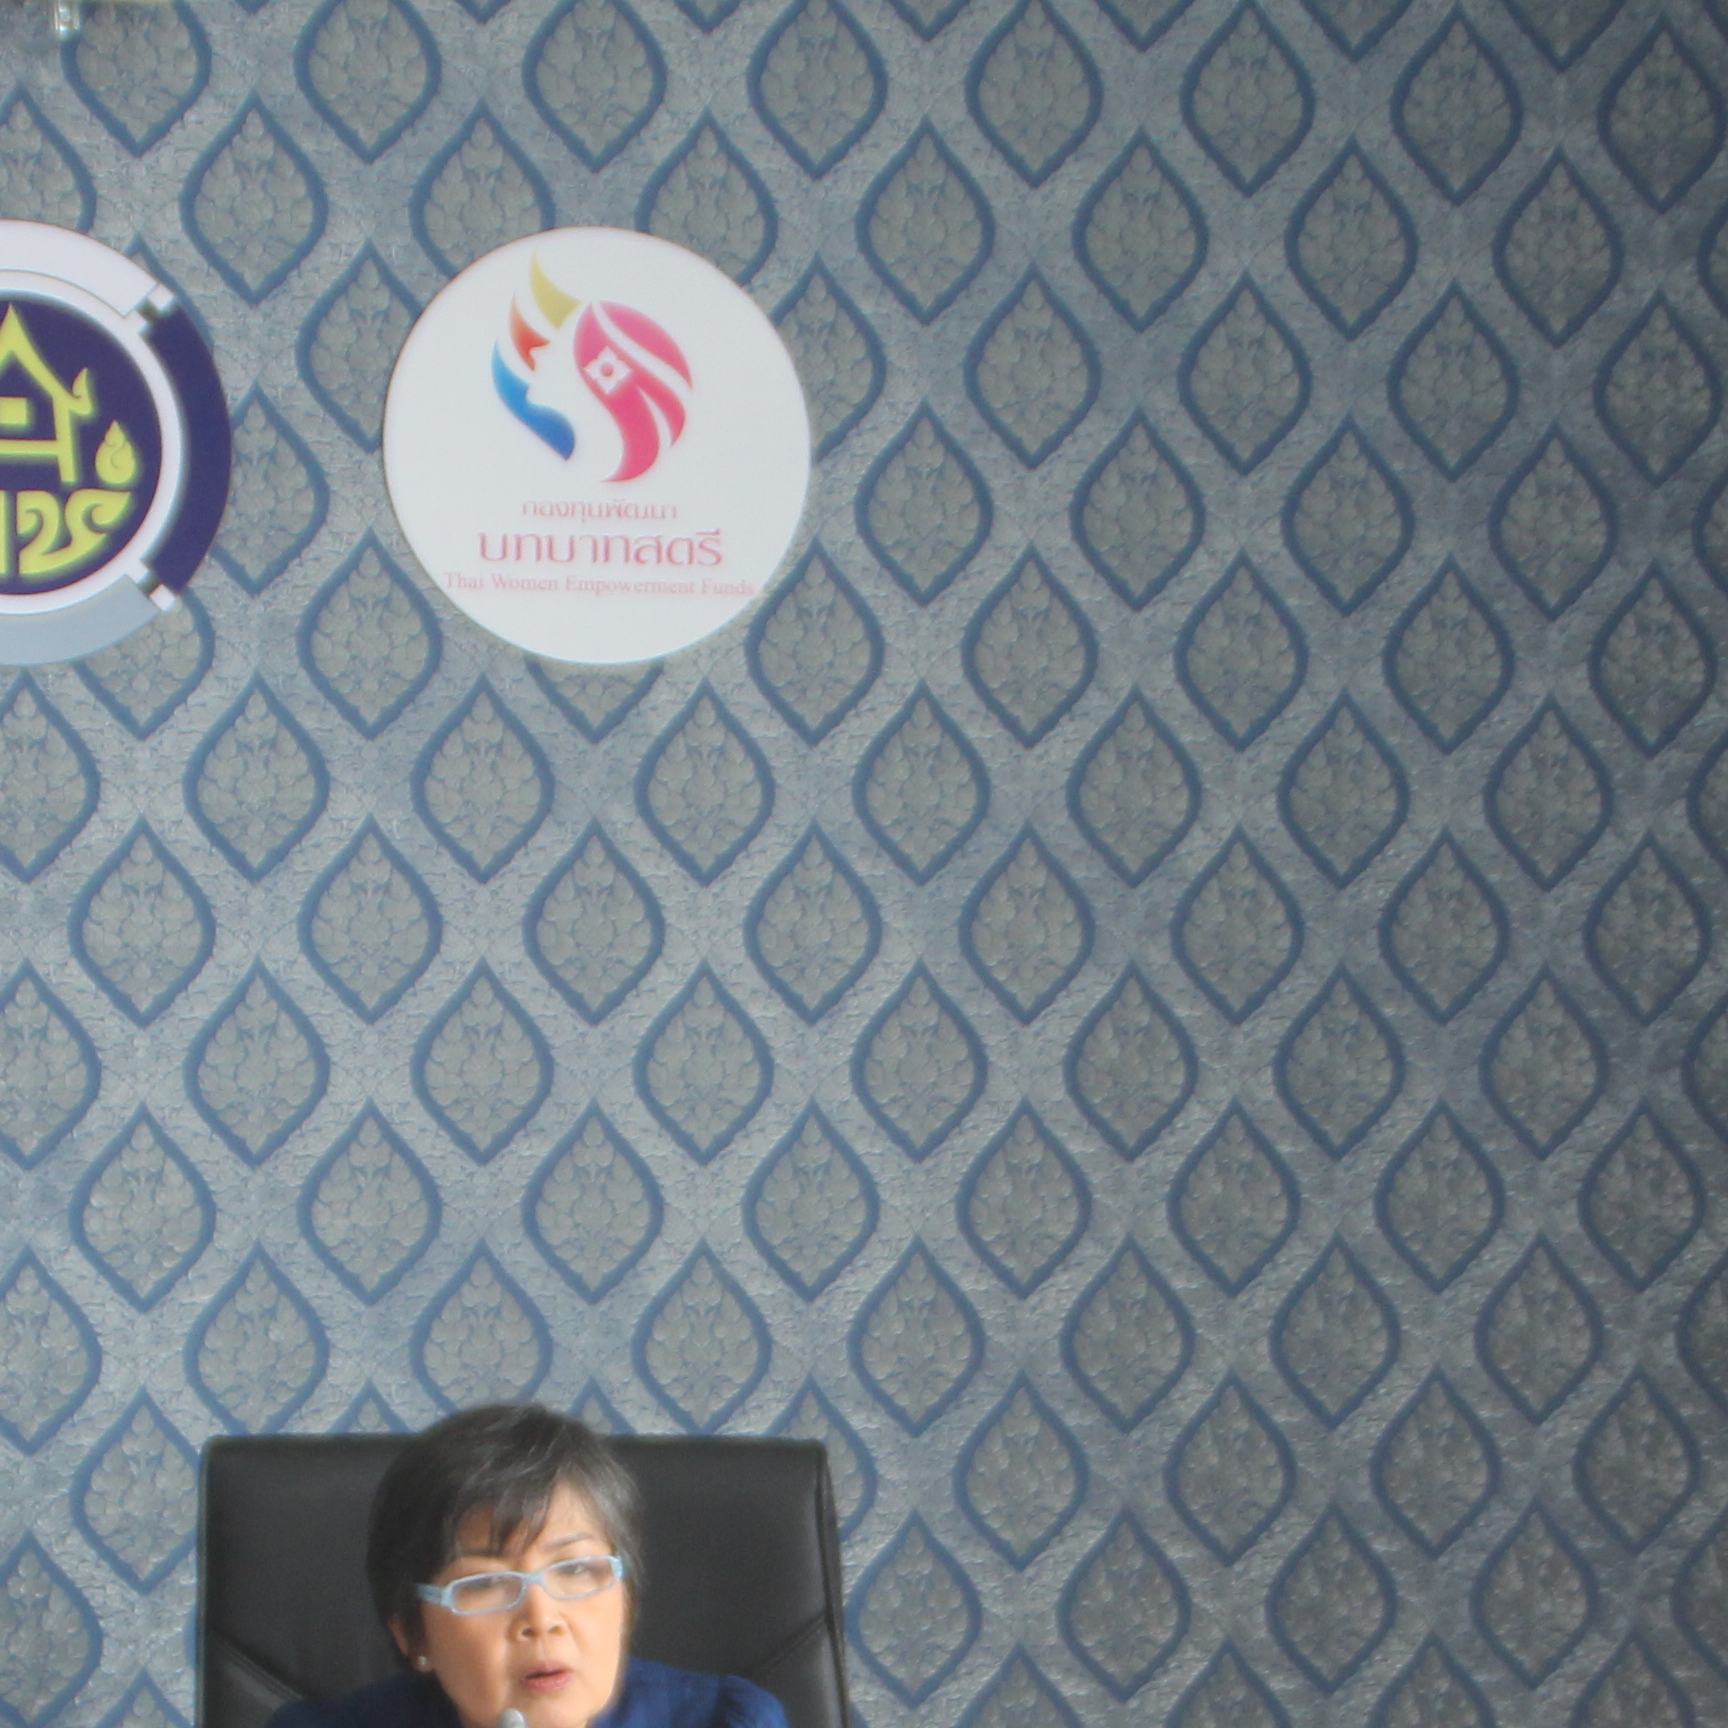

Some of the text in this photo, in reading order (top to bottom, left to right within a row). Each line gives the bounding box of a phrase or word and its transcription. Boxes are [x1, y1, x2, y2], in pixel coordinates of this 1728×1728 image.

[478, 527, 723, 567] บทบาทสตรี
[444, 571, 484, 590] Thai
[491, 573, 558, 591] Women
[565, 575, 694, 596] Empowerment
